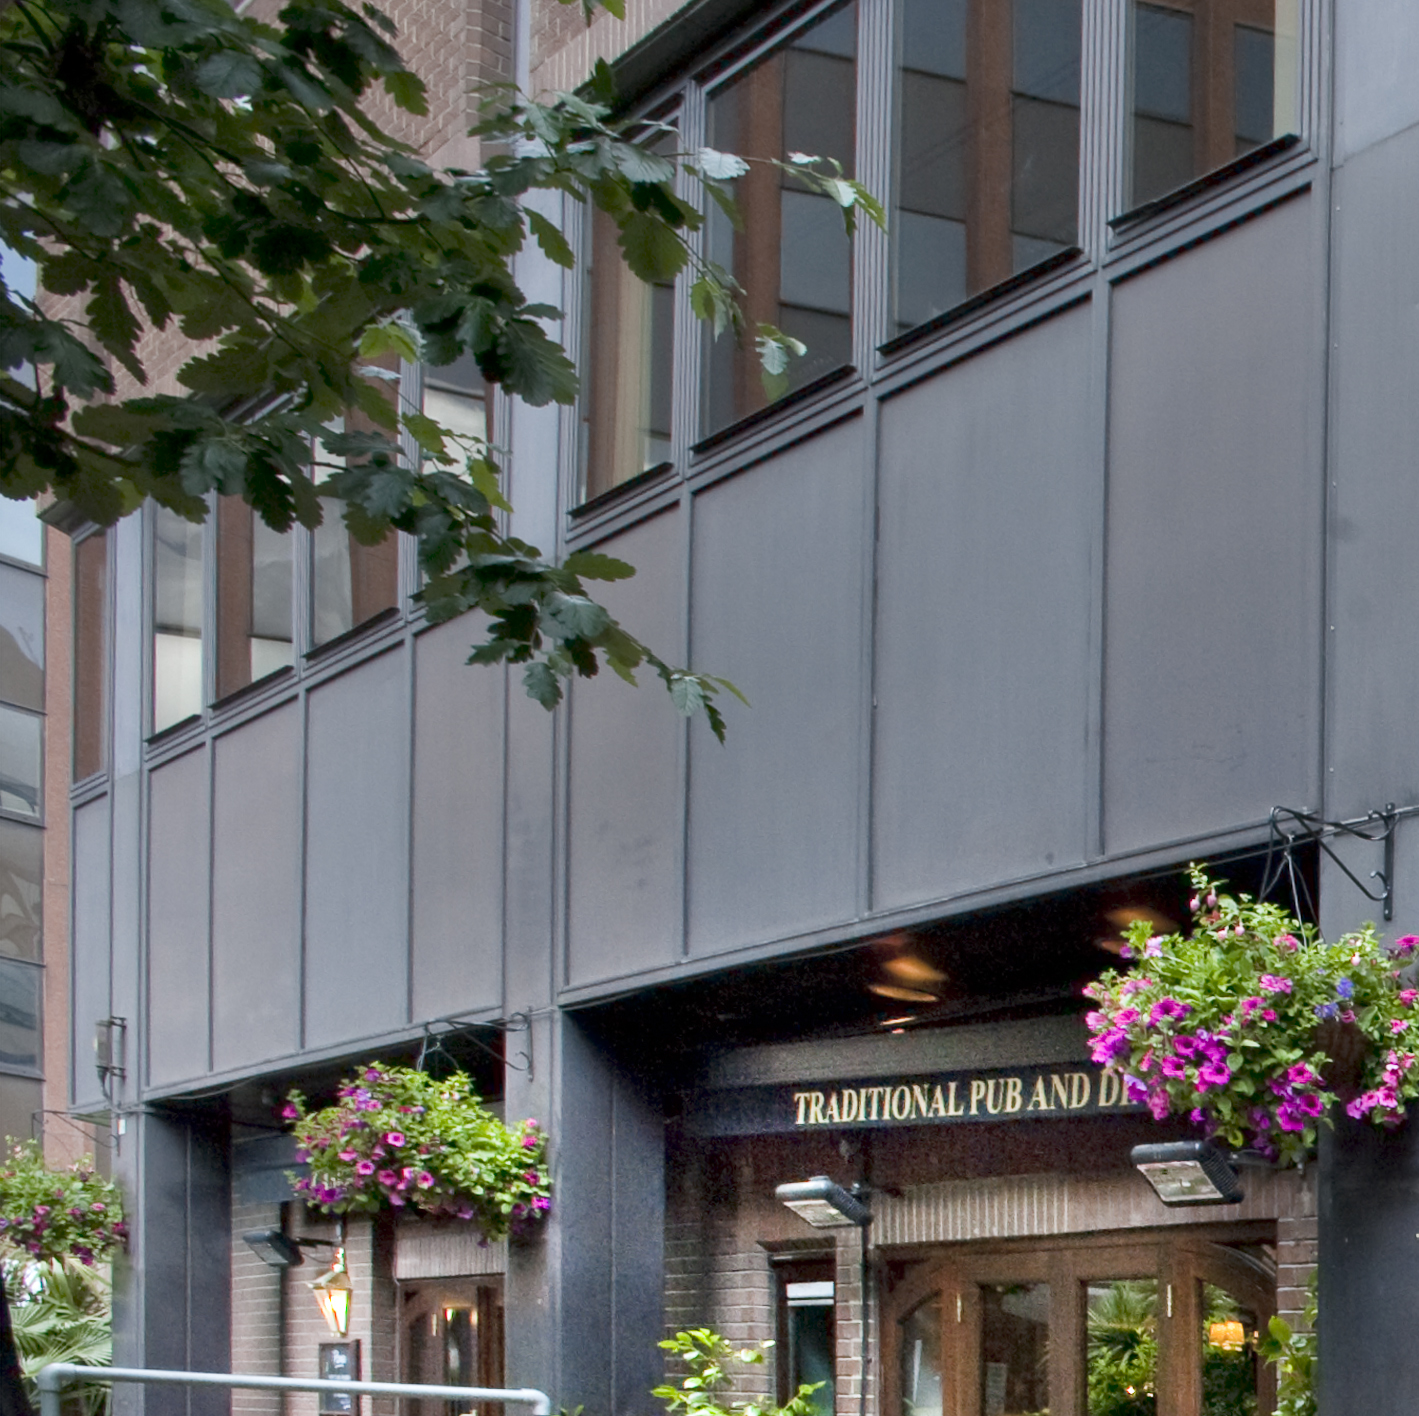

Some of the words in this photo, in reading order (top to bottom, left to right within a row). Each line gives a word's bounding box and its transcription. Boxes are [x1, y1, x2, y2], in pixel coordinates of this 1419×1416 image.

[794, 1081, 964, 1125] TRADITIONAL
[969, 1077, 1023, 1116] PUB
[1026, 1072, 1091, 1111] AND
